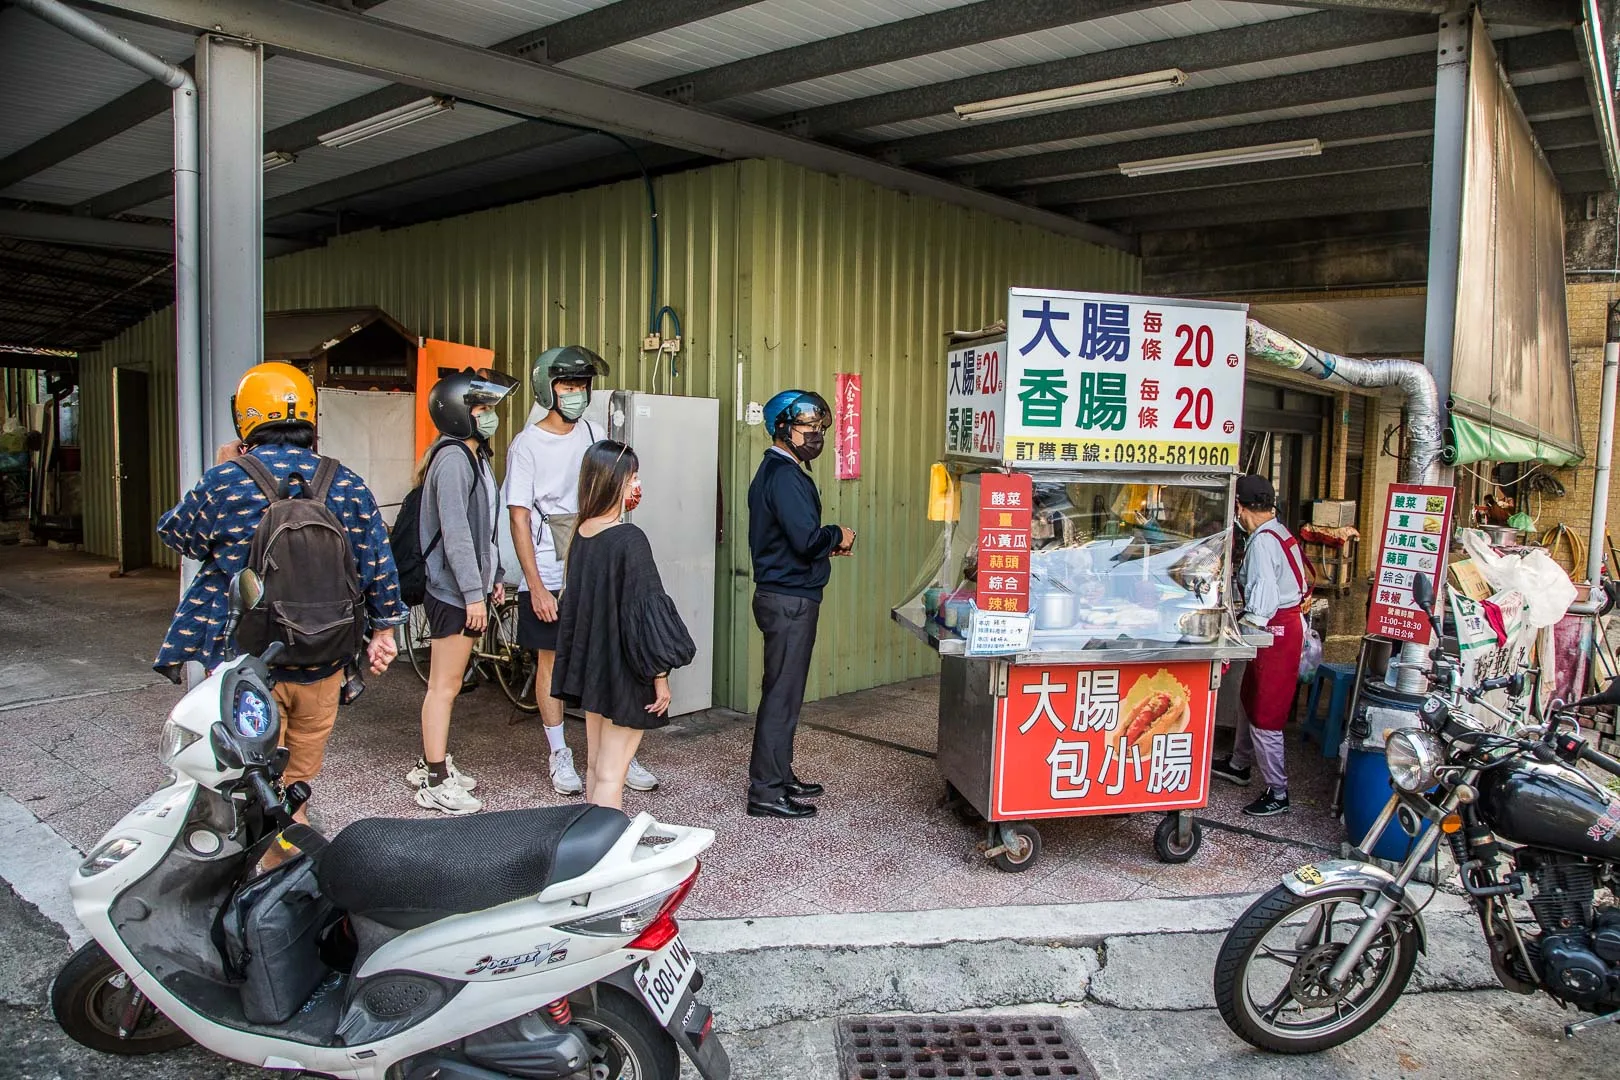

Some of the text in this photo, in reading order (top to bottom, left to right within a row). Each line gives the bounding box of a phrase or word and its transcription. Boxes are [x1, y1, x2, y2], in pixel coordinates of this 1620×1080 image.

[1019, 300, 1239, 368] 大腸 每條 20 元
[949, 350, 975, 396] 大腸
[982, 351, 998, 394] 20
[1017, 368, 1235, 434] 香腸 每條 20 元
[949, 407, 973, 453] 香腸
[980, 410, 995, 453] 20
[991, 491, 1021, 506] 酸菜
[1394, 495, 1417, 509] 酸菜
[982, 533, 1027, 548] 小黃瓜
[1388, 532, 1417, 548] 小黃瓜
[989, 555, 1020, 569] 蒜頭
[1386, 551, 1409, 566] 蒜頭
[988, 576, 1019, 591] 綜合
[1383, 571, 1404, 585] 綜合
[987, 597, 1018, 612] 辣椒
[1379, 589, 1402, 605] 辣椒
[1018, 669, 1121, 735] 大腸
[1045, 731, 1194, 800] 包小腸
